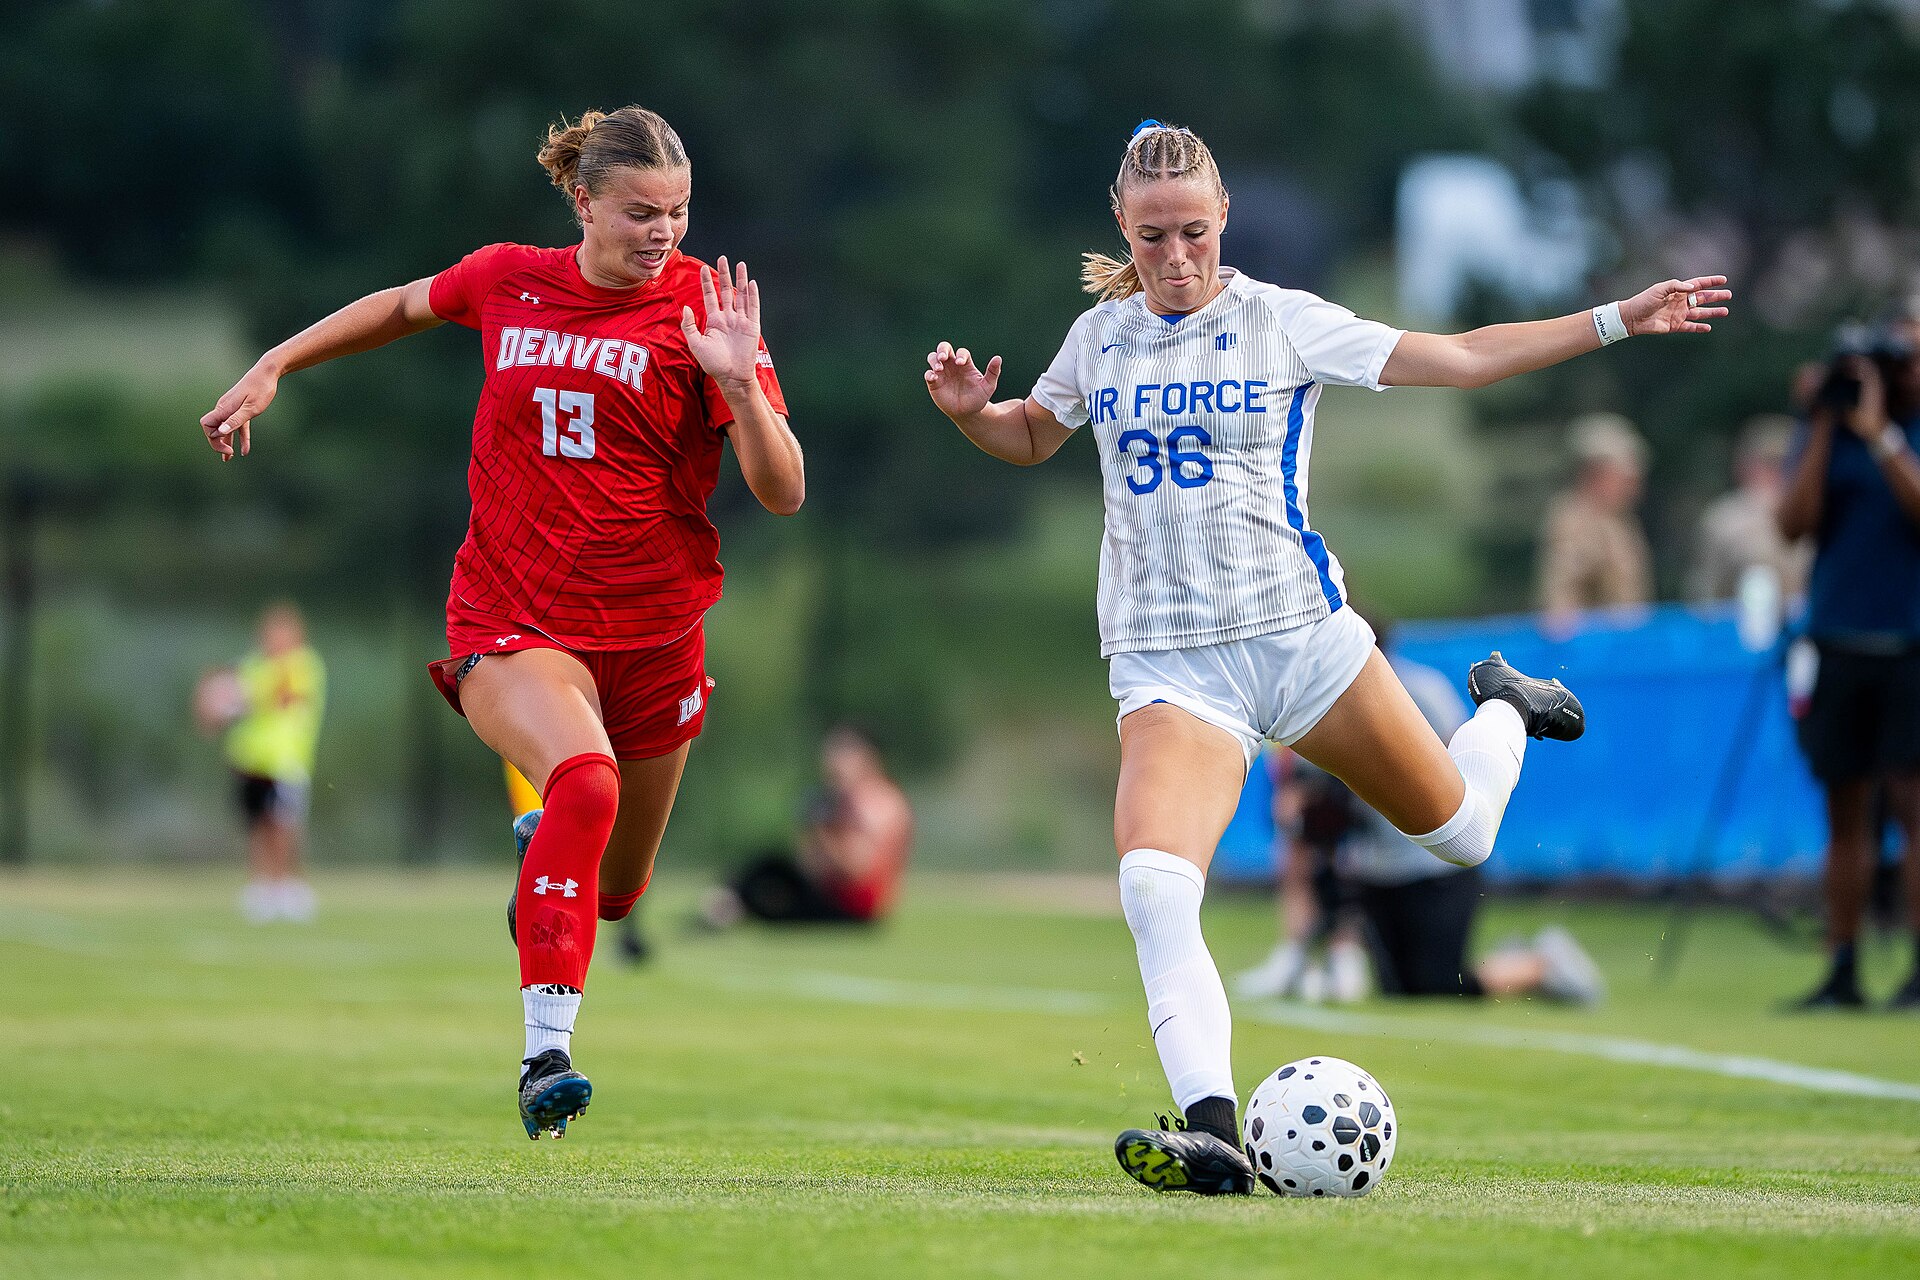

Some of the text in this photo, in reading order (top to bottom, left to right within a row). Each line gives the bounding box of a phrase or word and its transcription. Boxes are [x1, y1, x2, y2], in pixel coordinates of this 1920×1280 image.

[1595, 313, 1606, 337] Joshua
[496, 327, 649, 393] DENVER
[532, 386, 596, 459] 13
[1134, 380, 1268, 418] FORCE
[1117, 425, 1215, 496] 36
